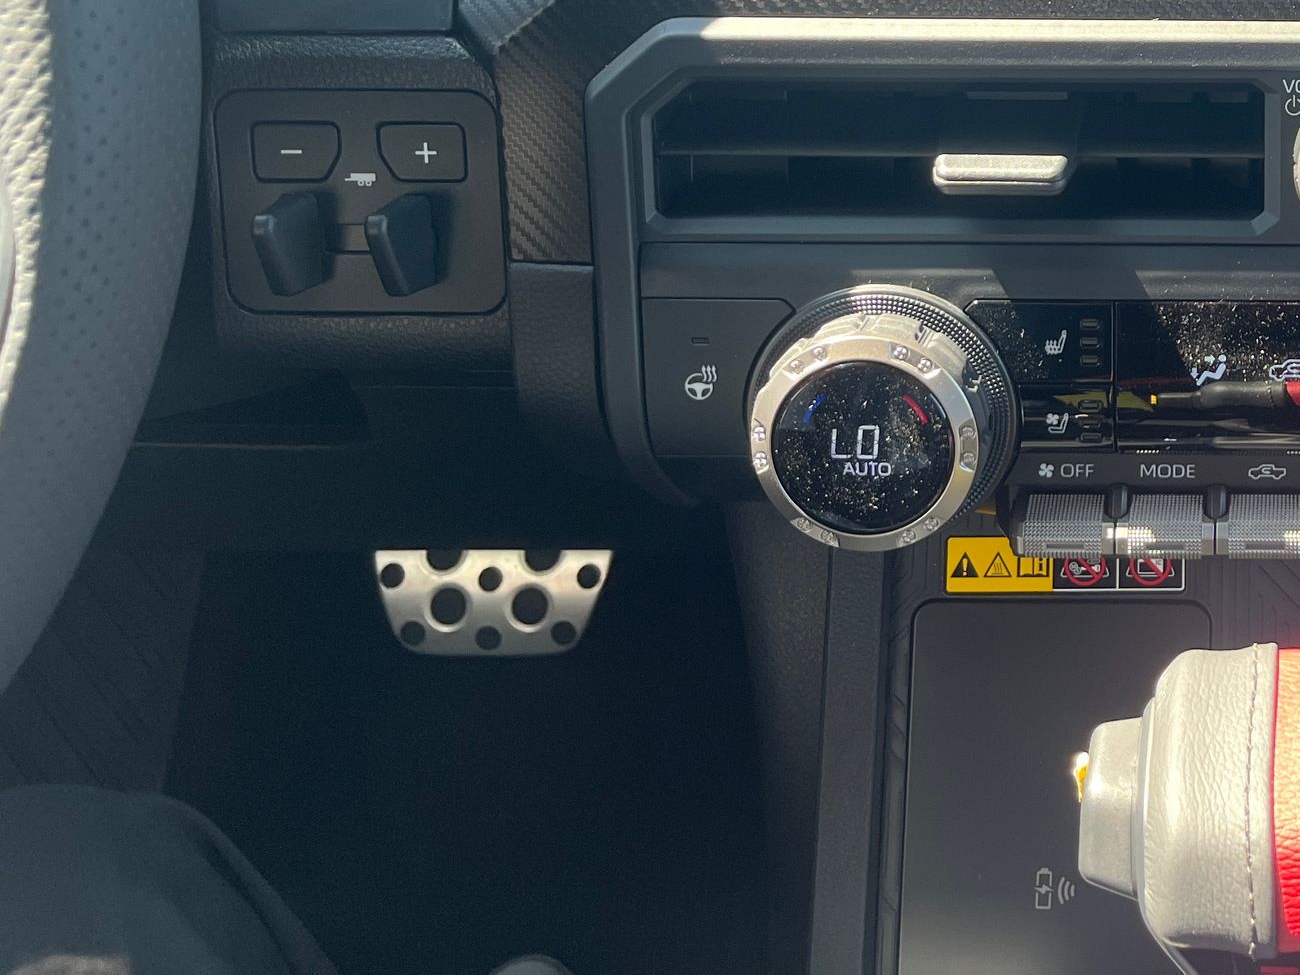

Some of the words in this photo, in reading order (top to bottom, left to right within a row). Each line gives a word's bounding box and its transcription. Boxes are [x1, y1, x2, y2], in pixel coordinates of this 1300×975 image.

[831, 425, 879, 460] LO
[843, 462, 892, 476] AUTO
[1060, 464, 1094, 478] OFF
[1140, 464, 1196, 478] MODE
